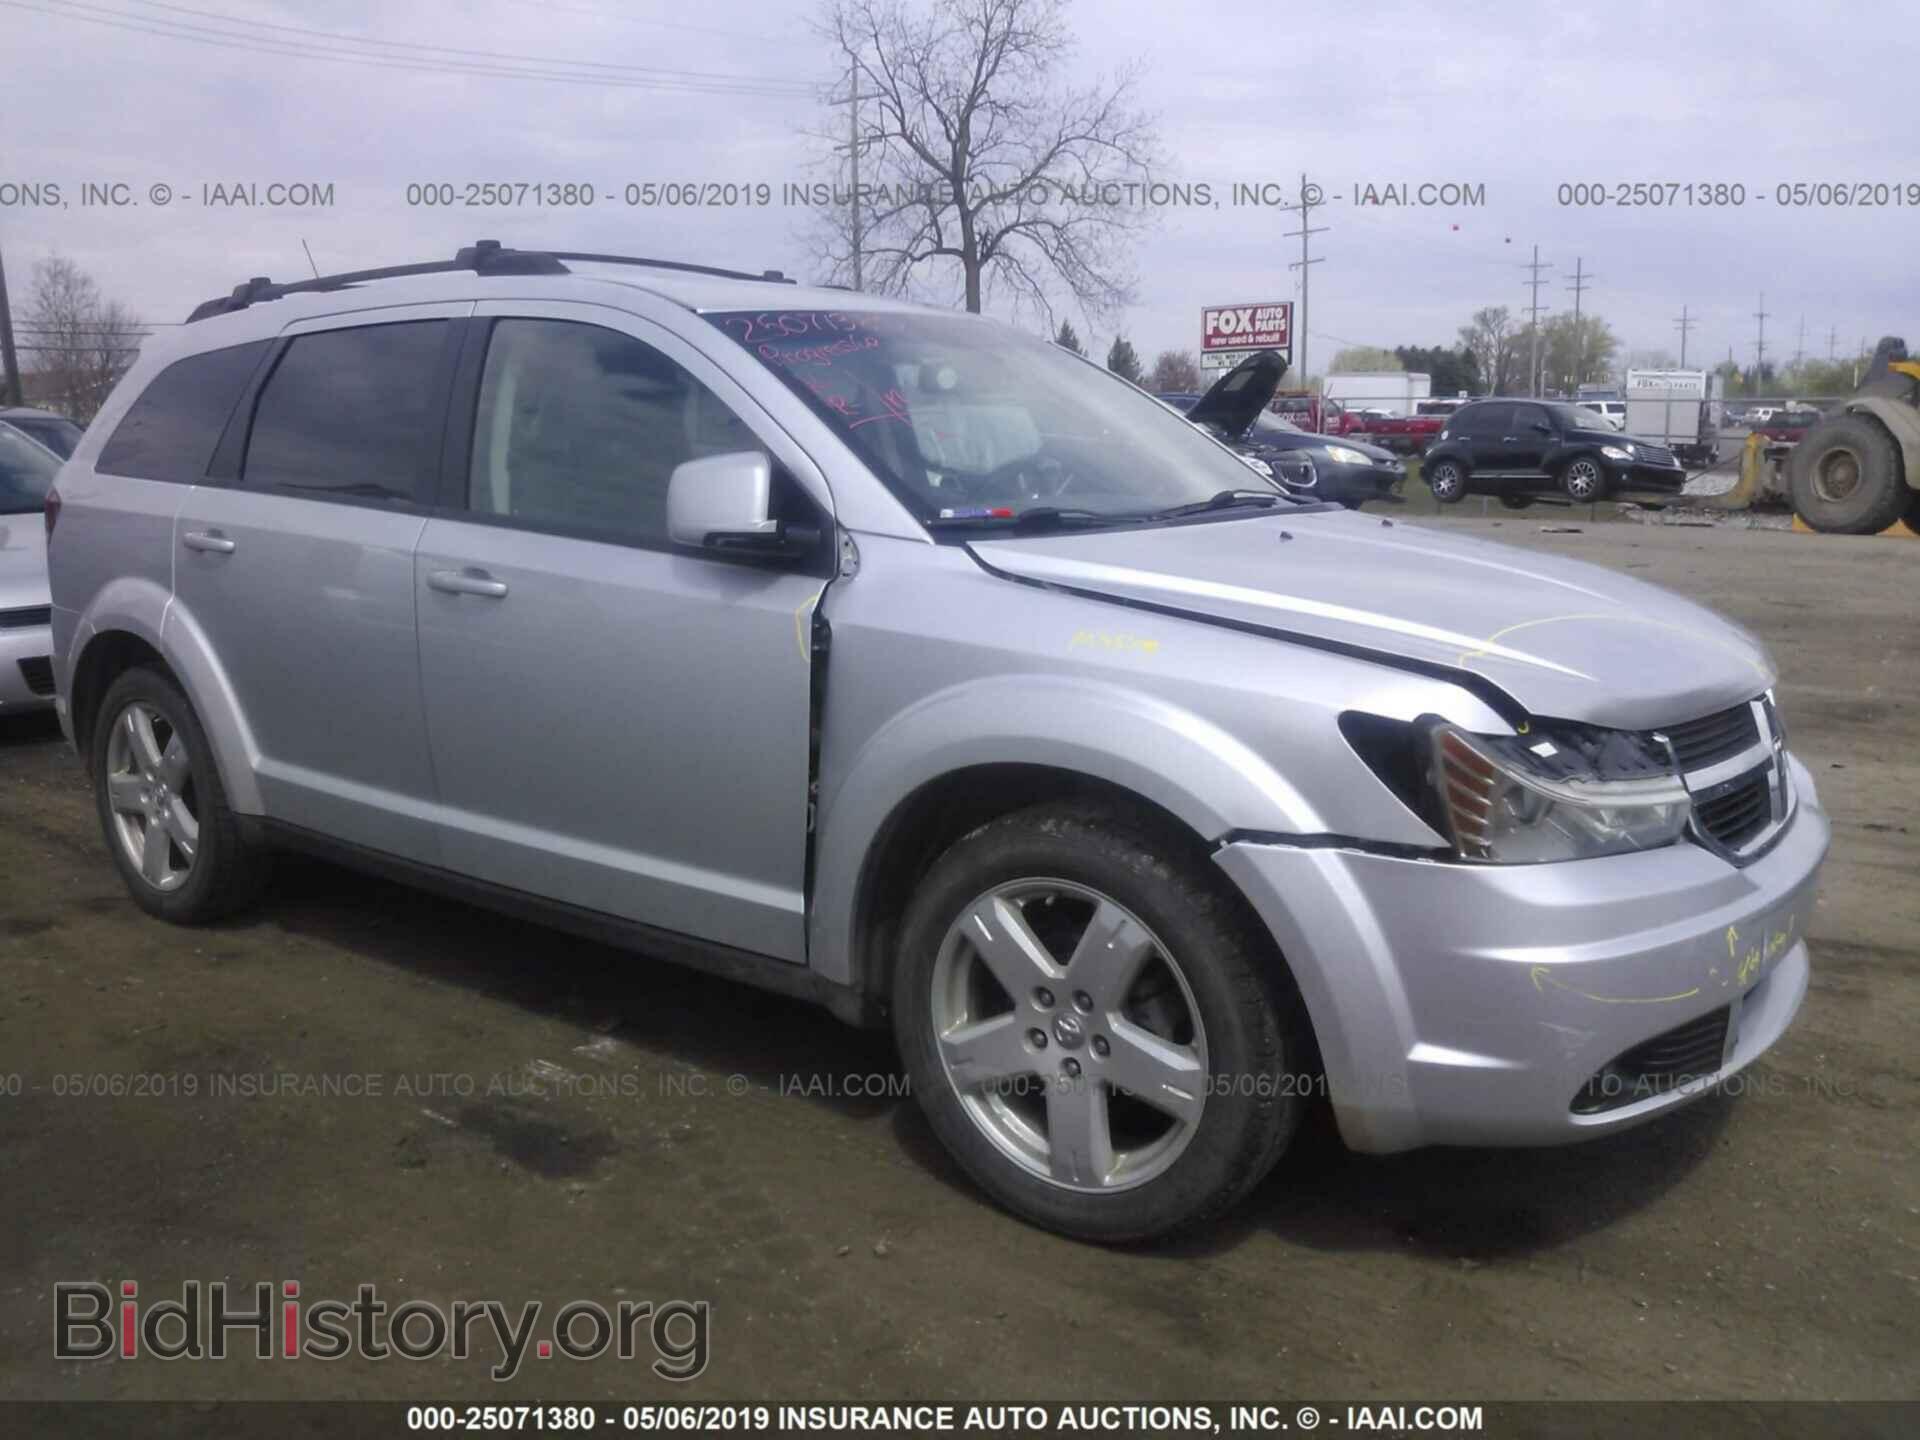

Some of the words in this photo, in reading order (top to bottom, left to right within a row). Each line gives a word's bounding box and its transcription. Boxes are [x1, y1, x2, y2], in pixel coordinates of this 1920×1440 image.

[1206, 310, 1254, 335] FOX
[1255, 307, 1283, 320] AUTO
[1255, 319, 1286, 332] PARTS
